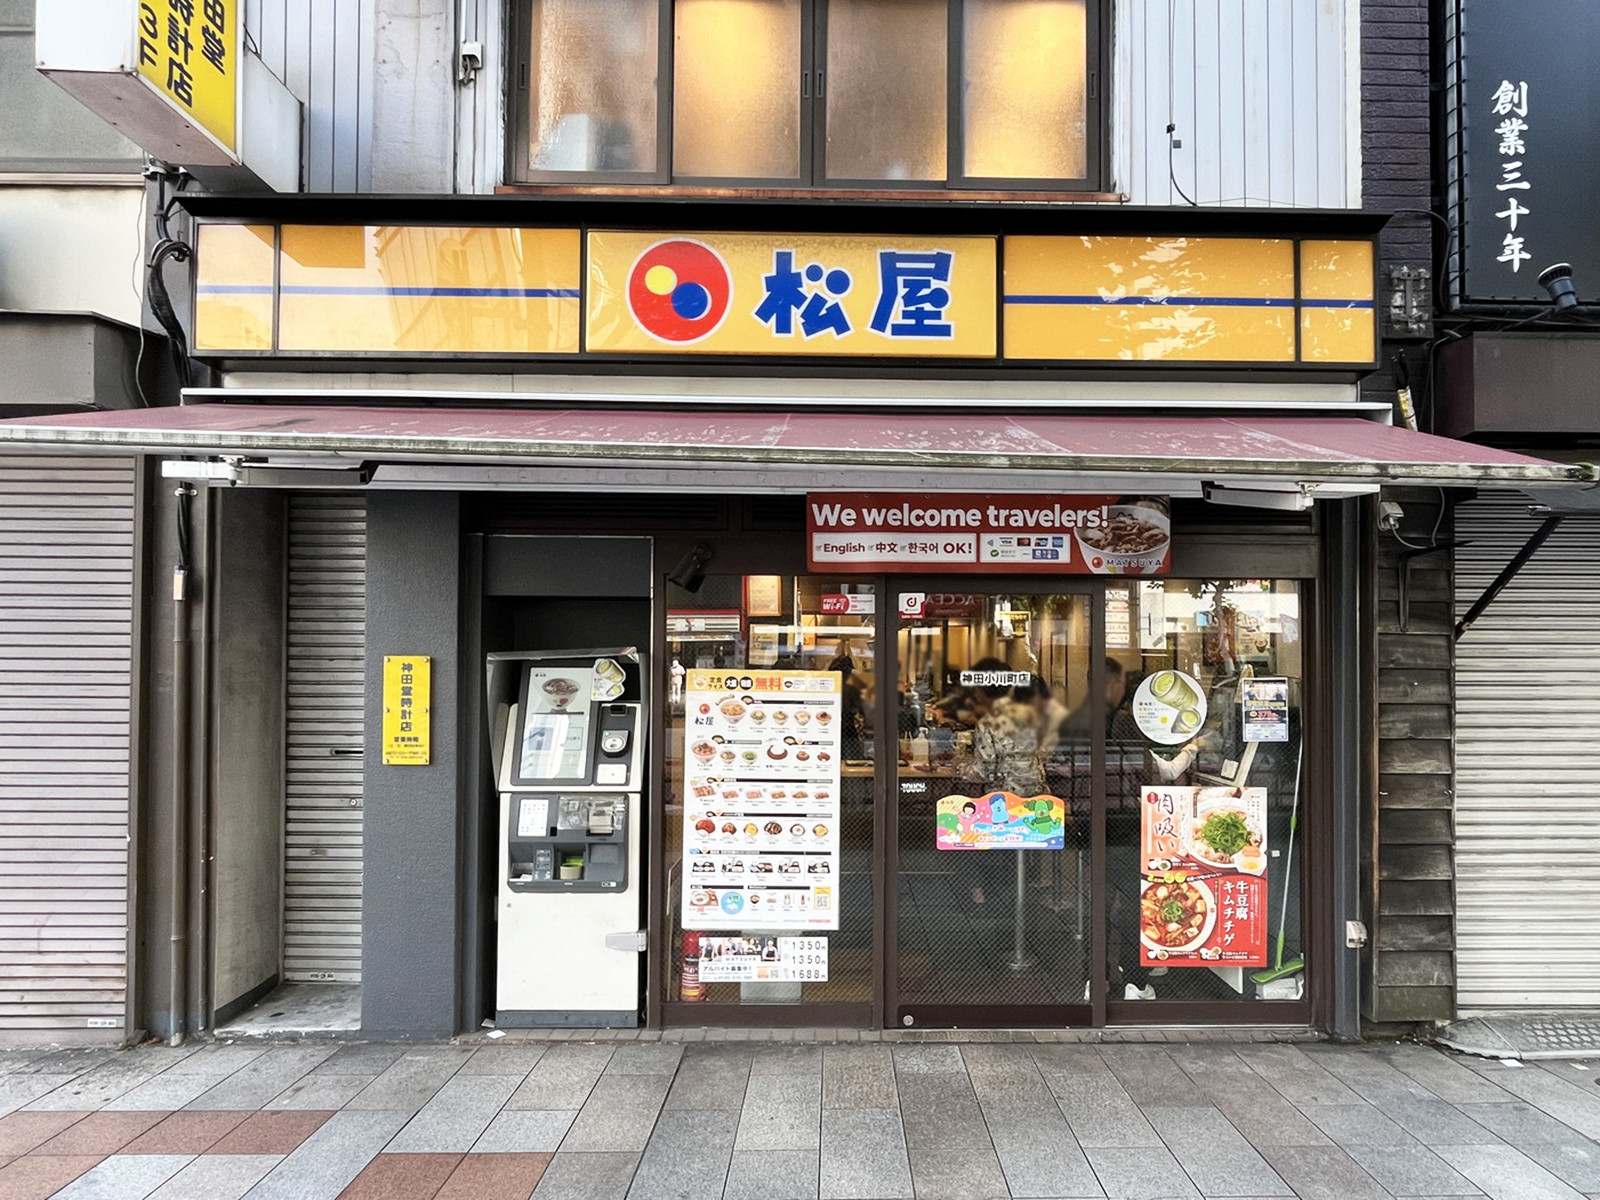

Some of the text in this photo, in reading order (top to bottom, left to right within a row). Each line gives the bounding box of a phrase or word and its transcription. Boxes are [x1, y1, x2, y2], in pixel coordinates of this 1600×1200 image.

[1491, 80, 1532, 273] 創業三十年
[753, 248, 955, 339] 松屋
[812, 503, 1109, 529] We welcome travelers!
[823, 542, 972, 555] English 中文 한국어 OK!
[1106, 559, 1163, 568] MATSUYA
[823, 602, 845, 610] Wi-Fi
[755, 677, 782, 690] 無料
[961, 673, 1031, 685] 神田小川町店
[694, 716, 714, 726] 松屋
[1154, 793, 1178, 852] 肉吸い
[1235, 880, 1249, 920] 牛豆腐
[1223, 880, 1235, 946] キムチチゲ
